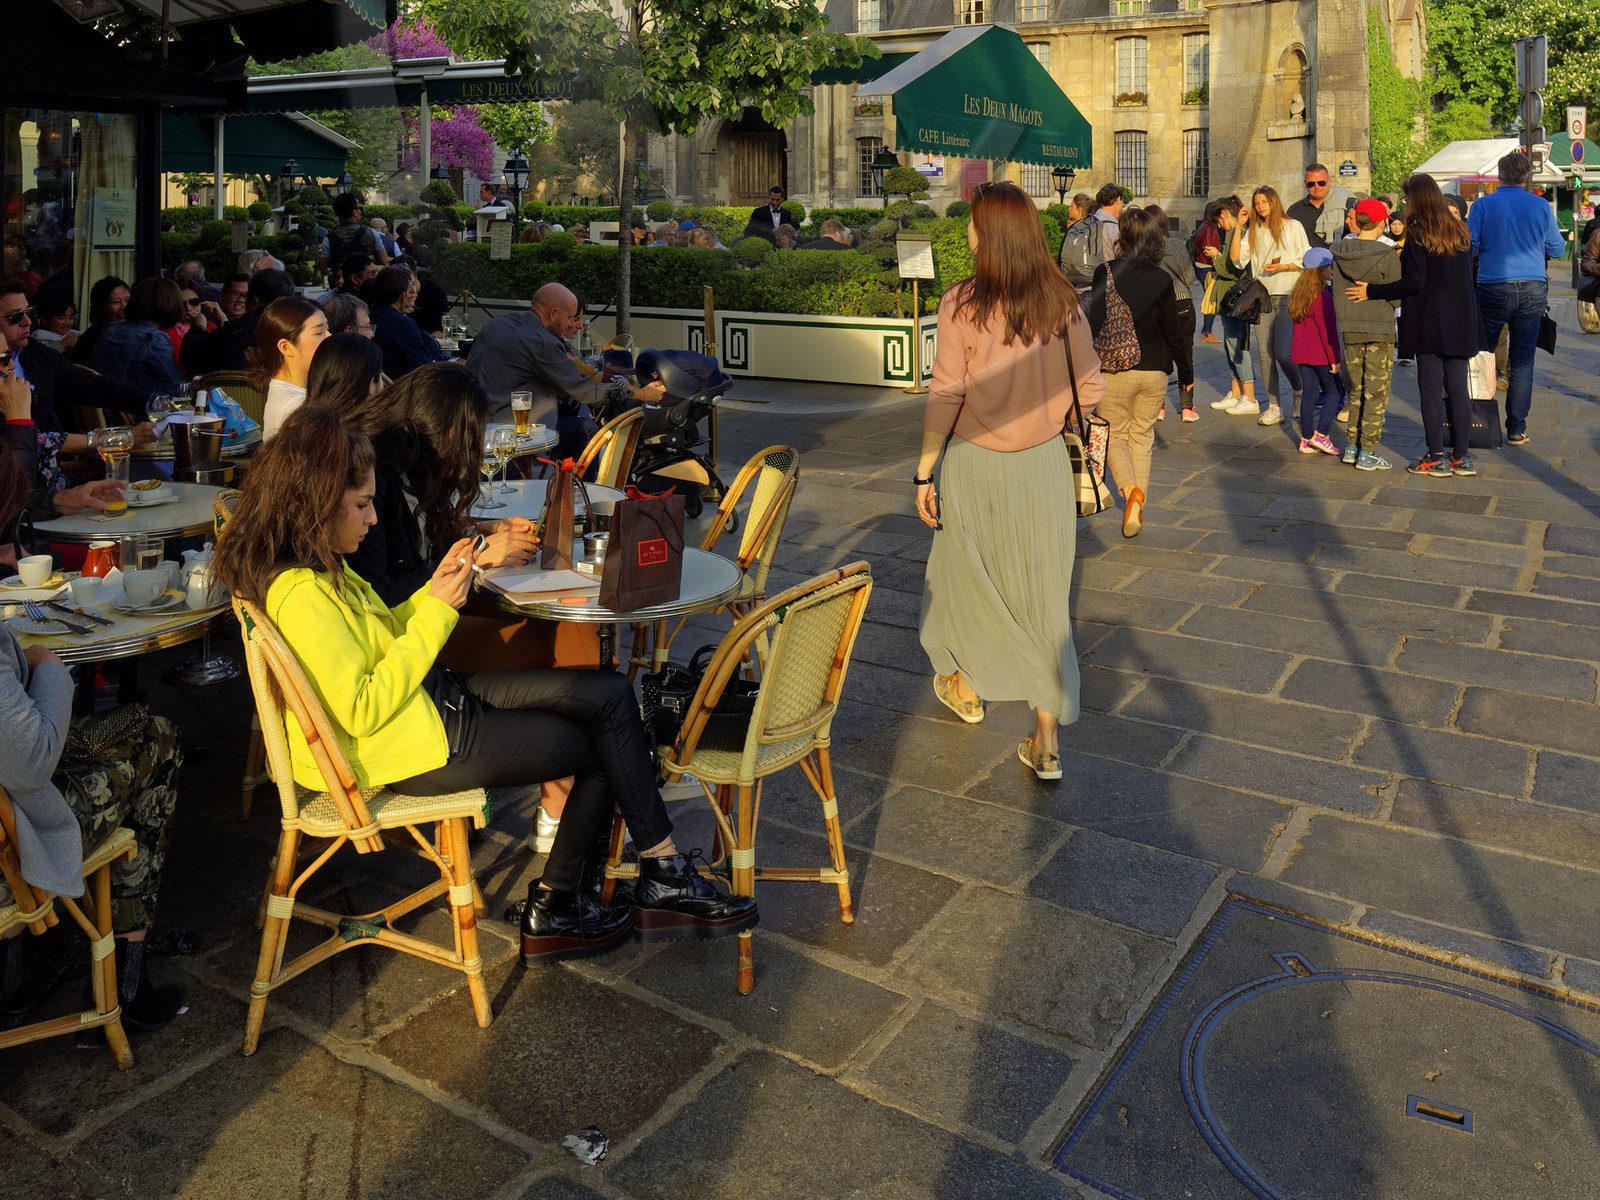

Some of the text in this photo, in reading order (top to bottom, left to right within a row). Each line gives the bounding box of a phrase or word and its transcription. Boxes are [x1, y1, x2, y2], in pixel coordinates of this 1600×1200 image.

[462, 79, 573, 97] LES DEUX MAOT
[964, 94, 1043, 127] LES DEUX MAGOTS
[918, 128, 940, 144] CAFE
[1042, 143, 1078, 158] RESTAURANT
